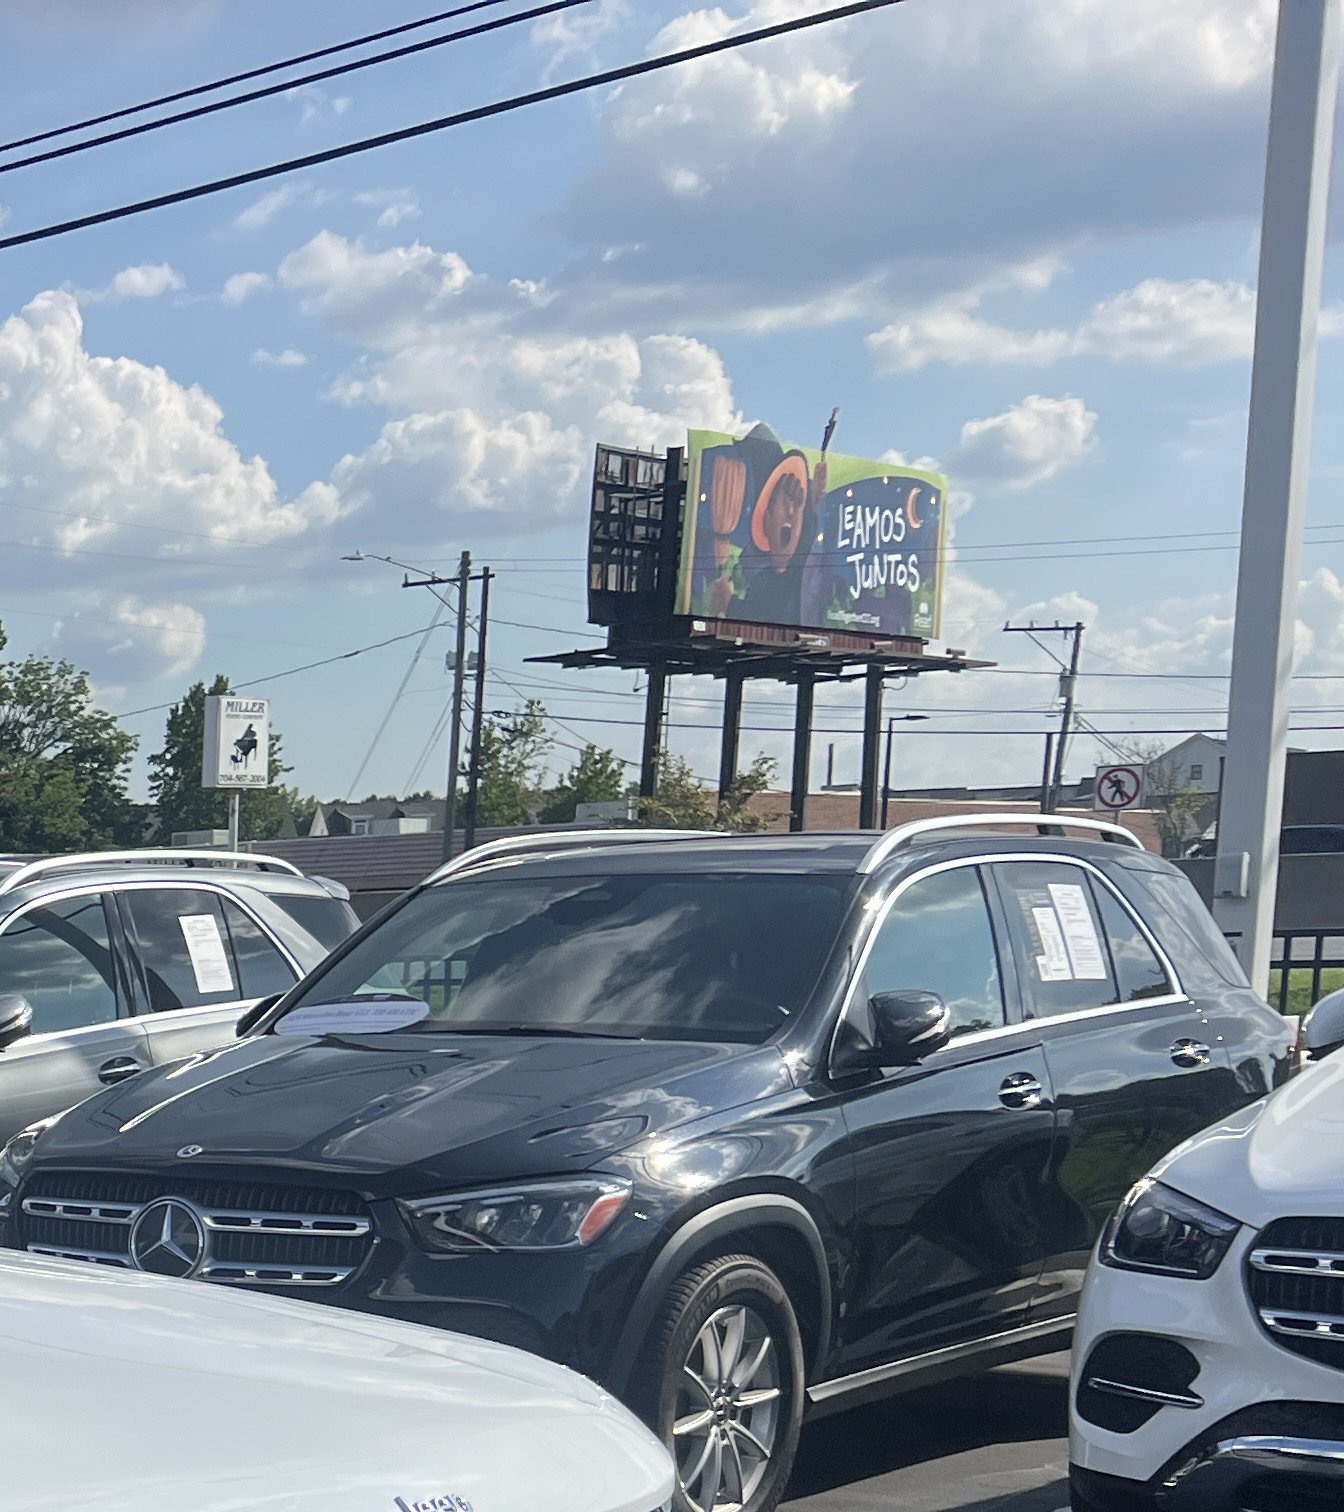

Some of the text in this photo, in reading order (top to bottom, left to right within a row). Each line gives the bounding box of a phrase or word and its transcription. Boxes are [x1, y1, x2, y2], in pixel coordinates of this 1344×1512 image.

[837, 503, 906, 549] LEAMOS
[846, 552, 920, 600] JUNTOS
[225, 701, 265, 713] MILLER
